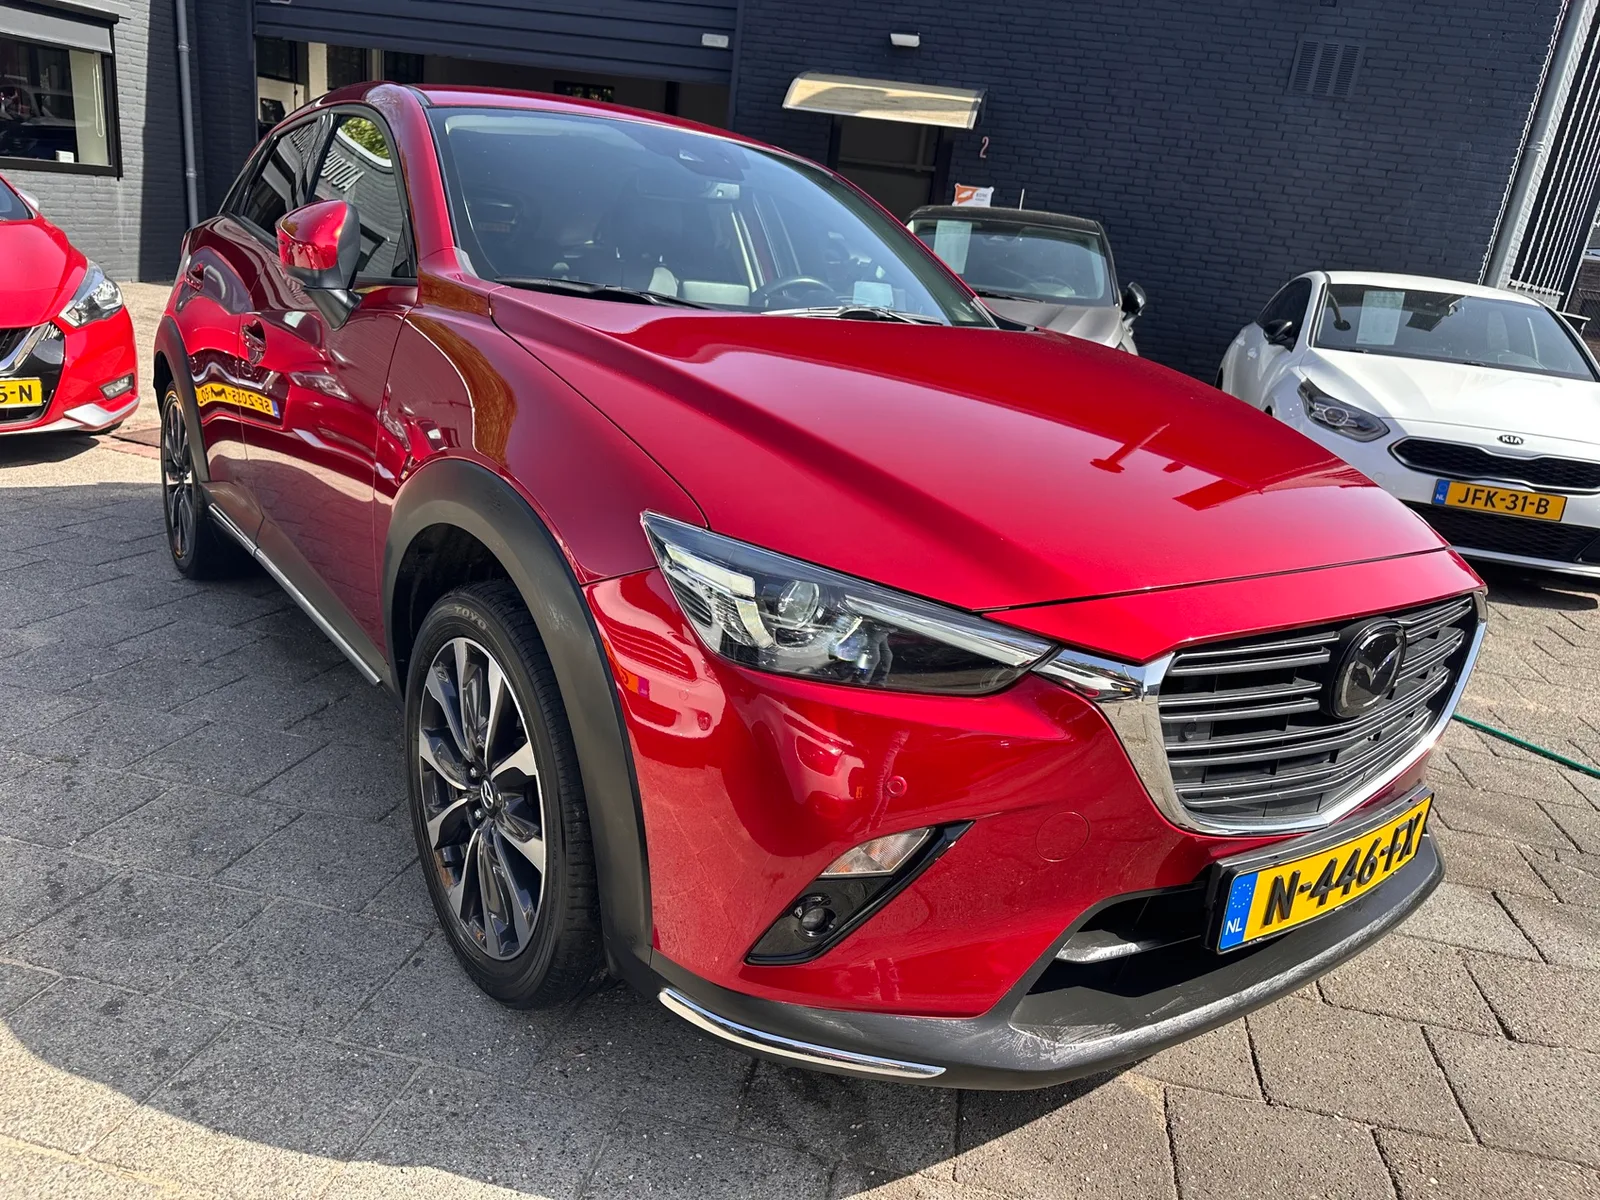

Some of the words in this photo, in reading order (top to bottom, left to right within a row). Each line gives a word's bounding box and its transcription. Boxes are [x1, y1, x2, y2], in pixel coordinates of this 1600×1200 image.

[979, 136, 989, 158] 2
[1501, 436, 1522, 444] KIA
[1435, 493, 1445, 501] NL
[1458, 487, 1550, 515] JFK-31-B
[454, 606, 487, 630] TOYO
[1225, 919, 1243, 936] NL
[1261, 812, 1423, 927] N-446-FX
